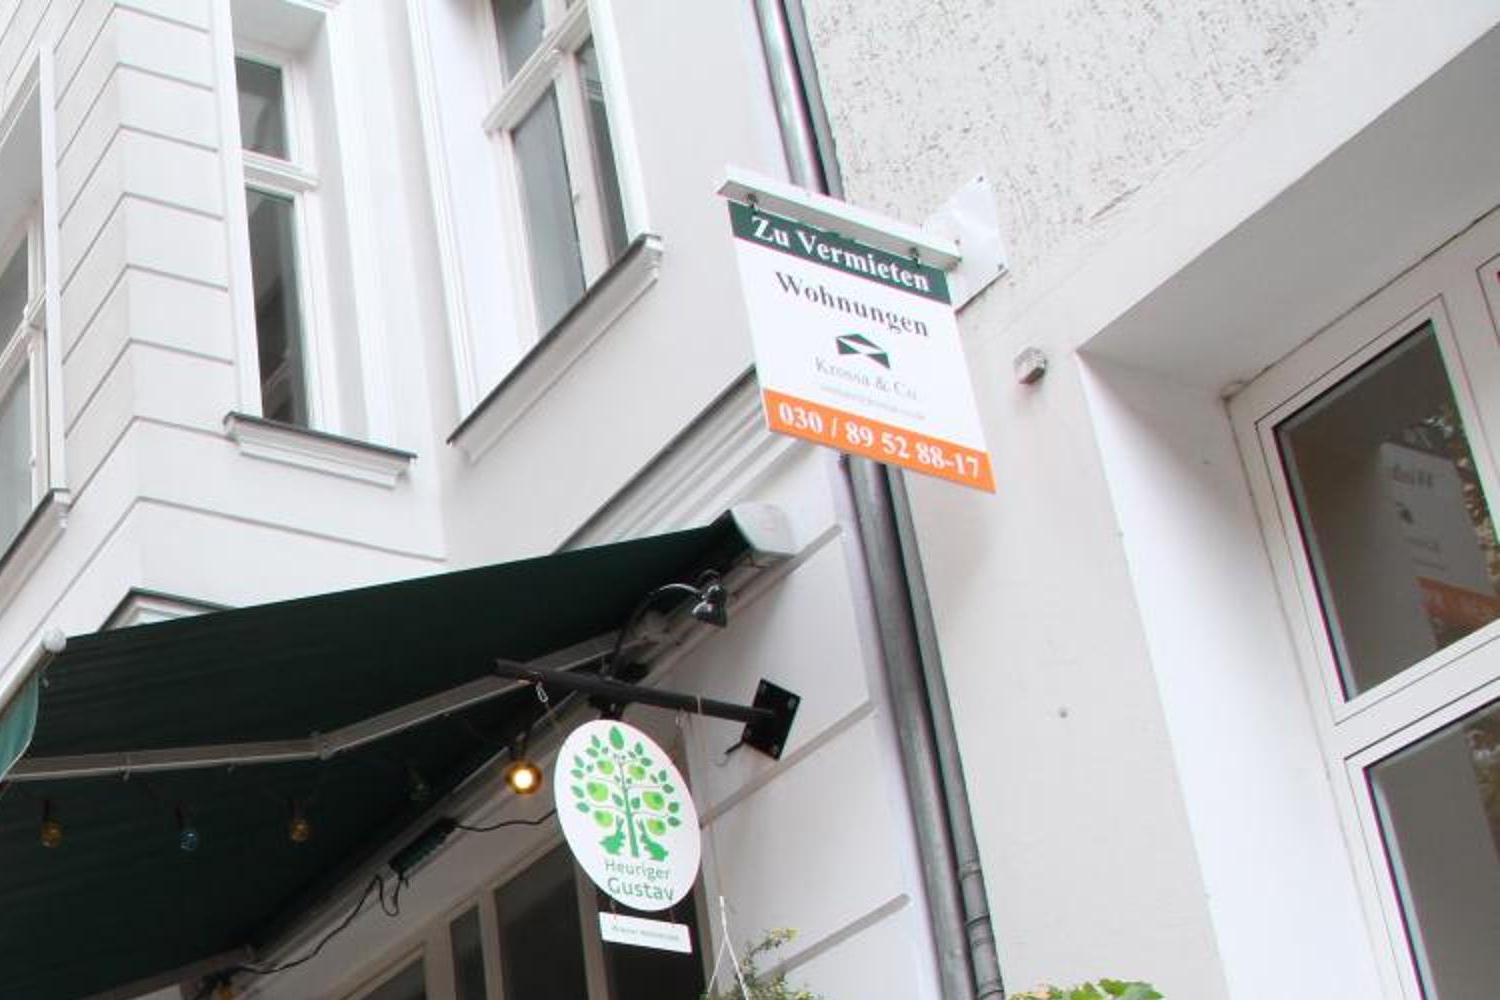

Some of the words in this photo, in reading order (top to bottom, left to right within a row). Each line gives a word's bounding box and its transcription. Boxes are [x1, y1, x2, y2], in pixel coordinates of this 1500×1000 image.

[751, 215, 790, 247] Zu
[797, 230, 932, 292] Vermieten
[775, 271, 929, 337] Wohnungen
[778, 402, 824, 434] 030
[831, 416, 839, 438] /
[845, 422, 874, 448] 89
[881, 432, 911, 459] 52
[915, 441, 980, 478] 88-17
[605, 859, 670, 882] Heuriger
[607, 877, 675, 902] Gustav
